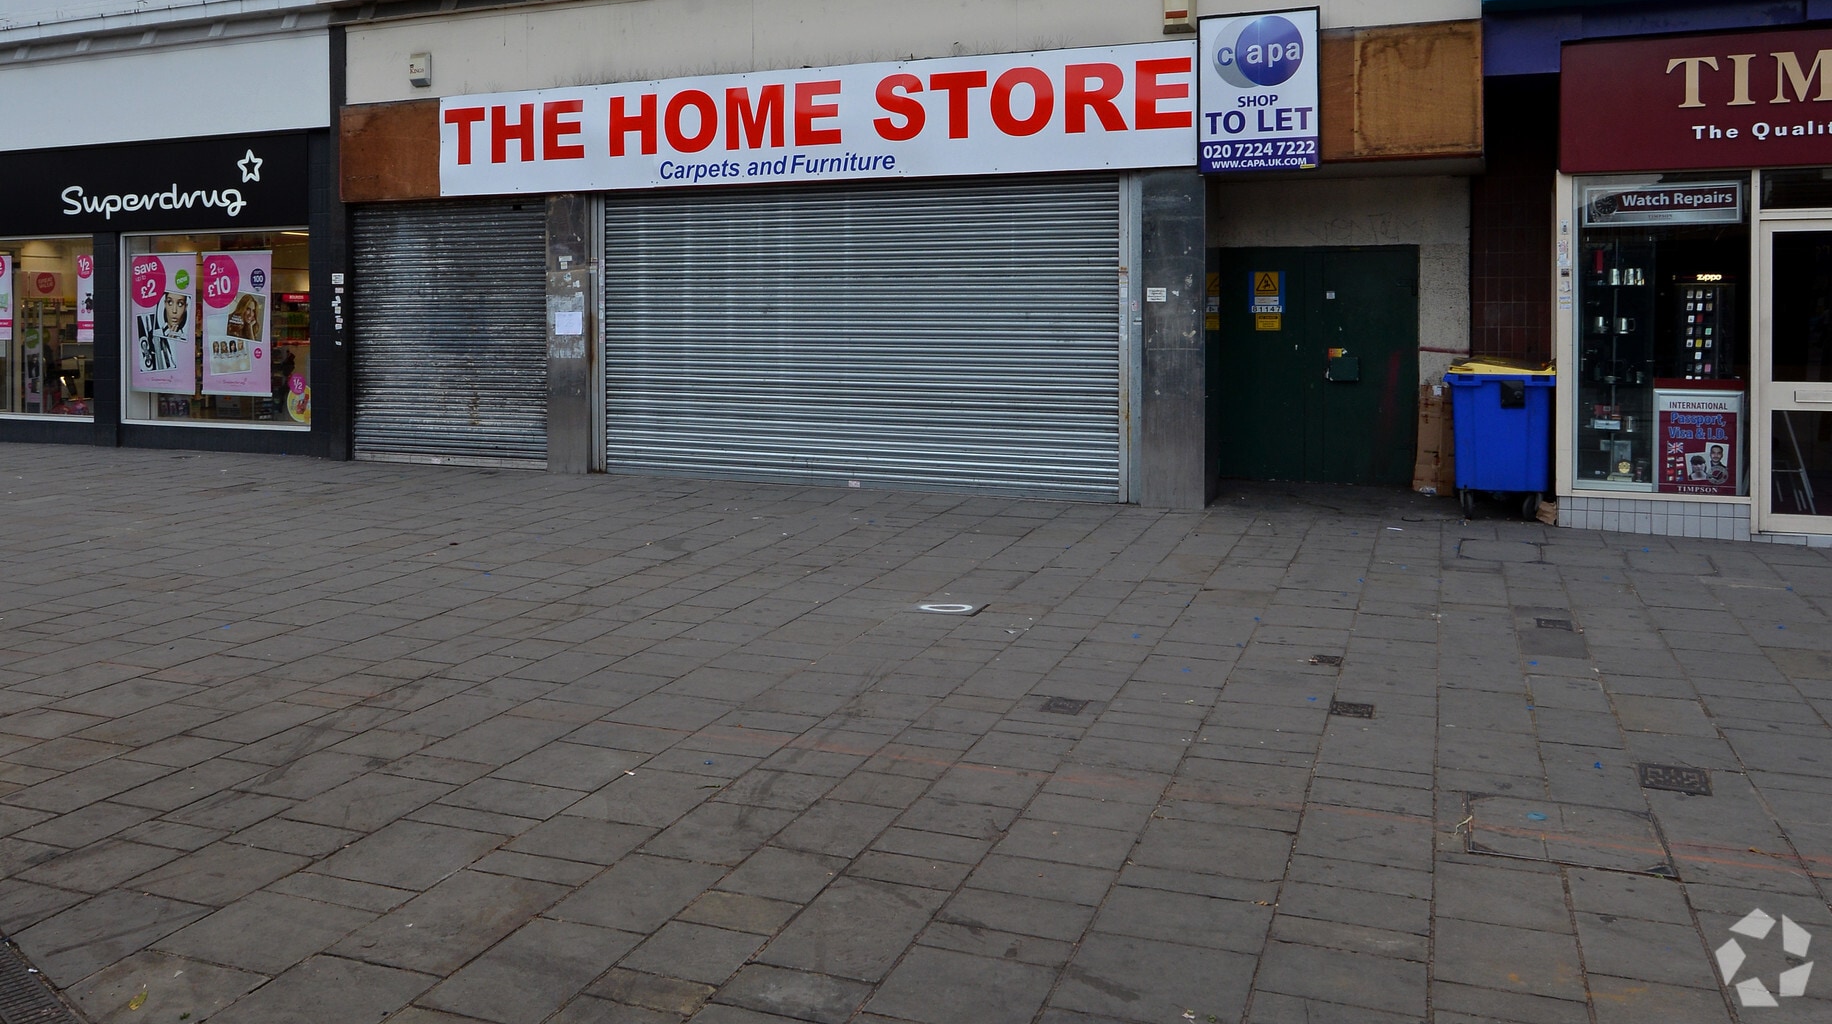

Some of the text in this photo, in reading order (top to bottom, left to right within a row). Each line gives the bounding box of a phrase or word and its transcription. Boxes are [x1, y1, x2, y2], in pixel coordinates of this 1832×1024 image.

[1217, 42, 1301, 67] capa
[1665, 49, 1832, 108] TIM
[1237, 94, 1279, 108] SHOP
[444, 57, 1193, 165] THE HOME STORE
[1205, 106, 1313, 135] TO LET
[1691, 124, 1739, 140] The
[1203, 140, 1316, 159] 020 7224 7222
[659, 152, 896, 183] Carpets and Furniture
[1211, 157, 1307, 169] WWW.CAPA.UK.COM
[61, 183, 247, 220] Superdrug
[1622, 191, 1733, 207] Watch Repairs
[134, 261, 158, 275] save
[209, 263, 217, 276] 2
[176, 275, 188, 284] new
[207, 275, 231, 297] £10
[252, 275, 264, 283] 100
[140, 279, 157, 299] £2
[1669, 401, 1728, 410] INTERNATIONAL
[1670, 411, 1726, 427] Passport,
[1668, 426, 1728, 440] Visa & I.D.
[1677, 485, 1718, 493] TIMPSON
